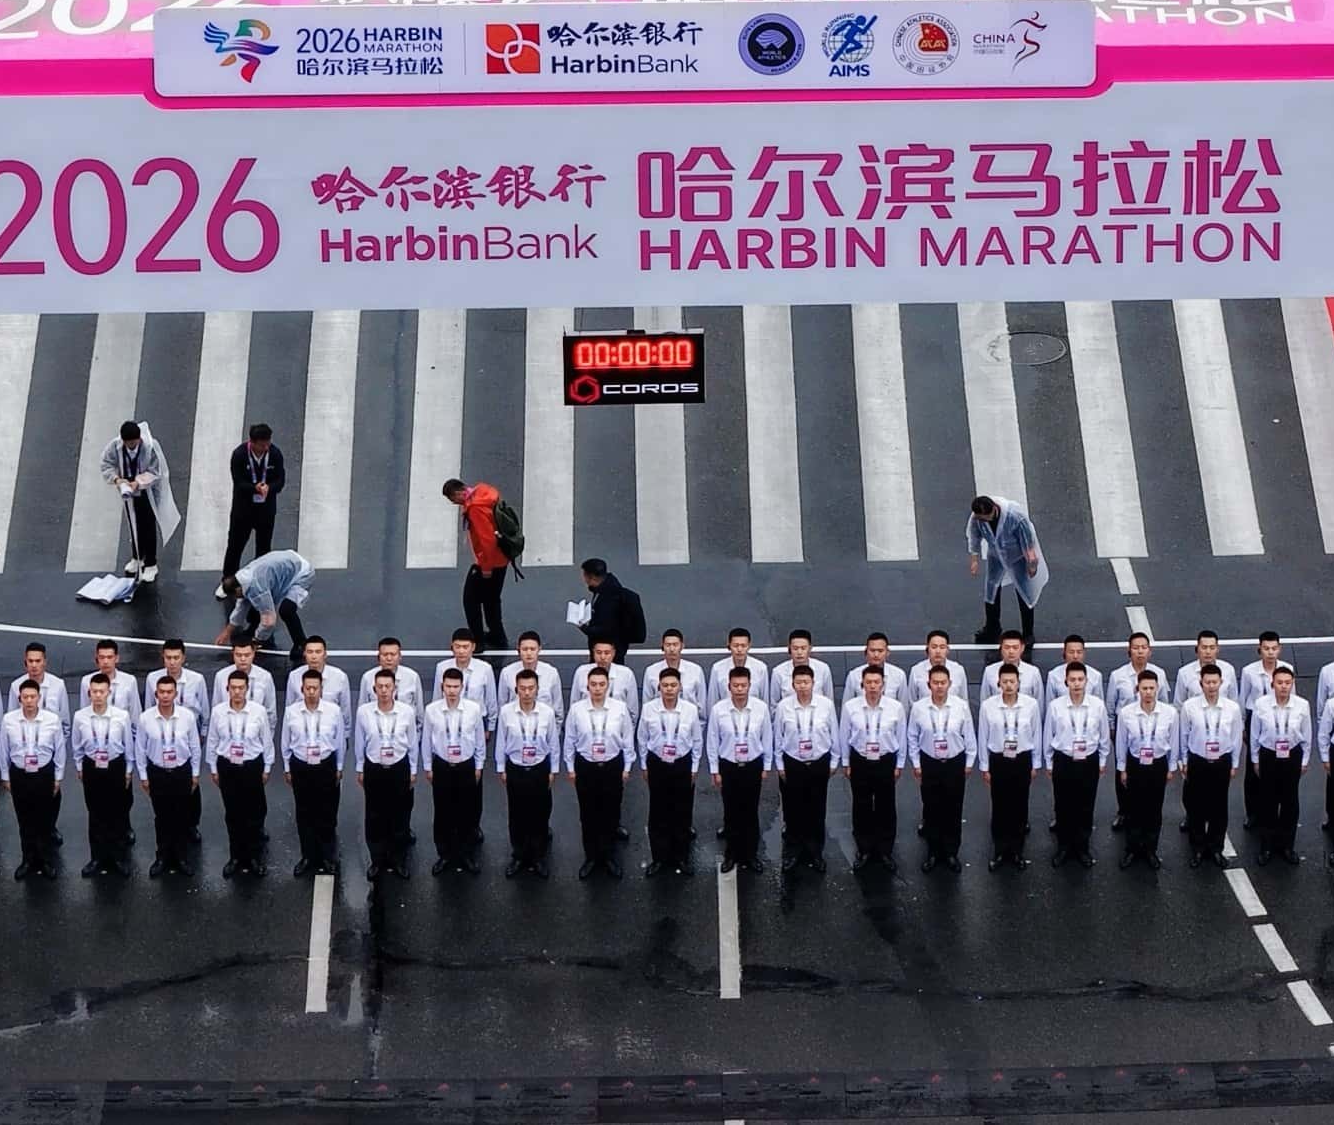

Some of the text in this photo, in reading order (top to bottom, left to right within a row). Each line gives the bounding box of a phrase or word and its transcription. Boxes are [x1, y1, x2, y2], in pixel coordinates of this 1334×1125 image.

[296, 28, 360, 54] 2026
[364, 26, 443, 41] HARBIN
[547, 21, 703, 48] 哈尔滨银行
[973, 33, 1016, 44] CHINA
[364, 42, 443, 53] MARATHON
[296, 56, 443, 76] 哈尔滨马拉松
[551, 54, 698, 74] HarbinBank
[829, 64, 871, 77] AIMS
[311, 164, 606, 213] 哈尔滨银行
[638, 138, 1282, 223] 哈尔滨马拉松
[321, 224, 598, 263] HarbinBank
[640, 220, 1281, 271] HARBIN MARATHON
[576, 340, 693, 366] 00:00:00
[602, 383, 699, 394] COROS
